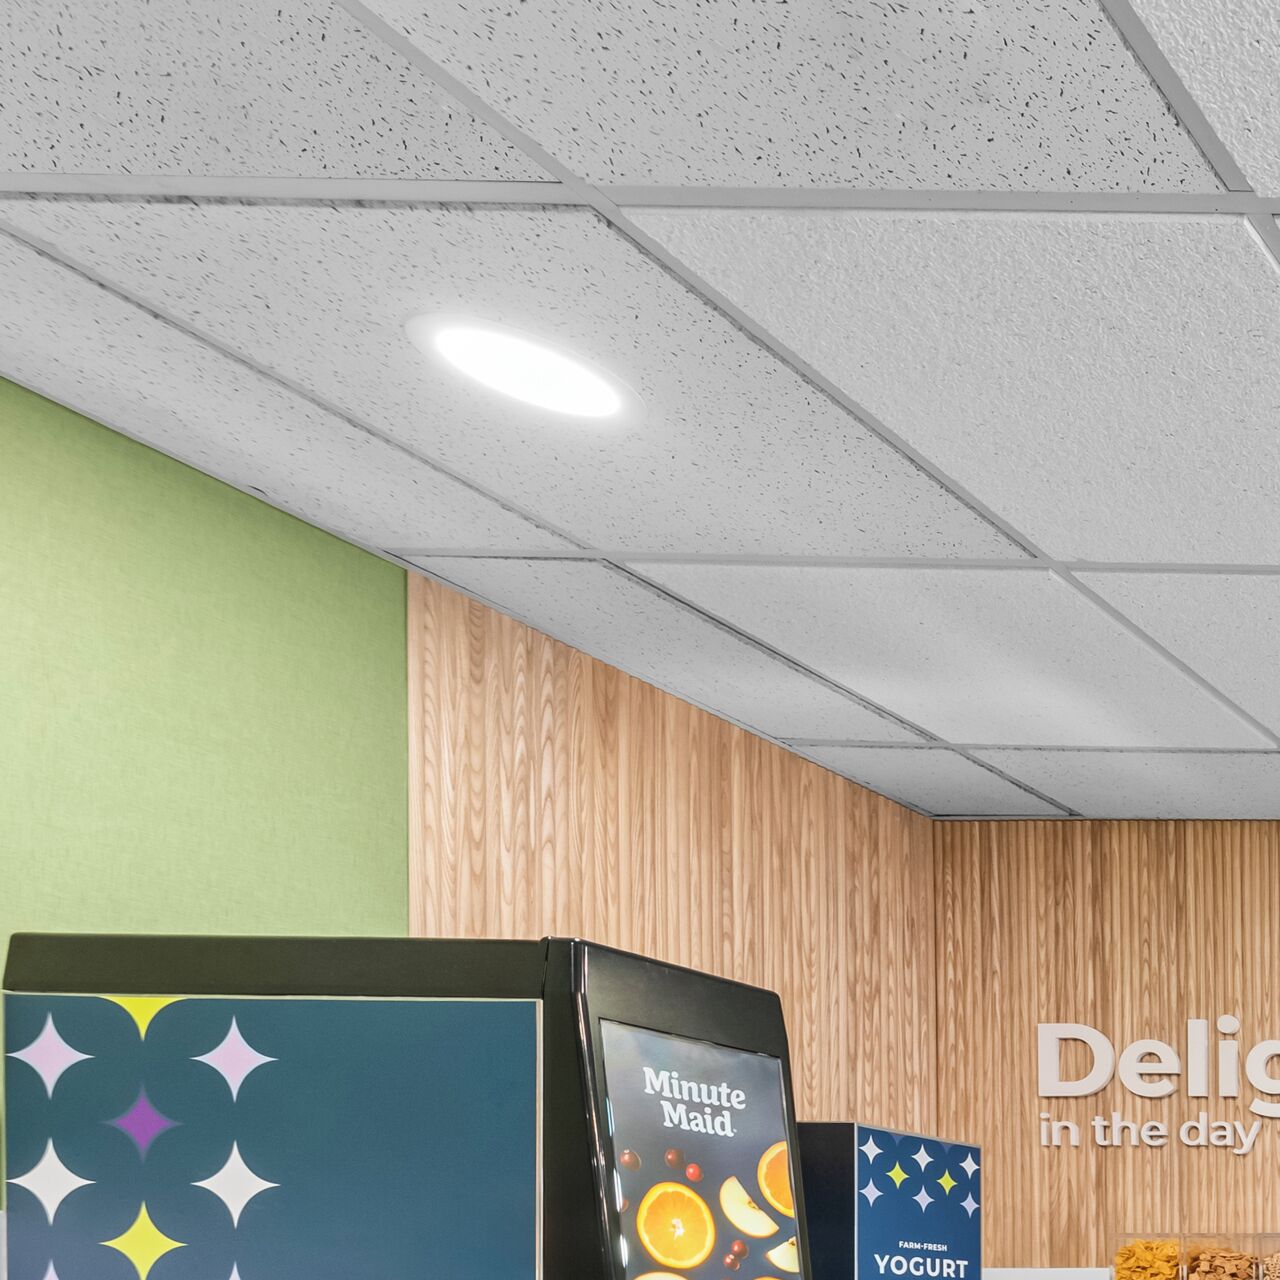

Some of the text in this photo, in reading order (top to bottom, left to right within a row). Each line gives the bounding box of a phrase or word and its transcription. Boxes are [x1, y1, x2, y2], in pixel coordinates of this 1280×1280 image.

[642, 1066, 746, 1110] Minute
[660, 1100, 736, 1137] Maid
[1040, 1112, 1262, 1155] in the day
[898, 1240, 948, 1252] FARM-FRESH
[873, 1253, 969, 1279] YOGURT
